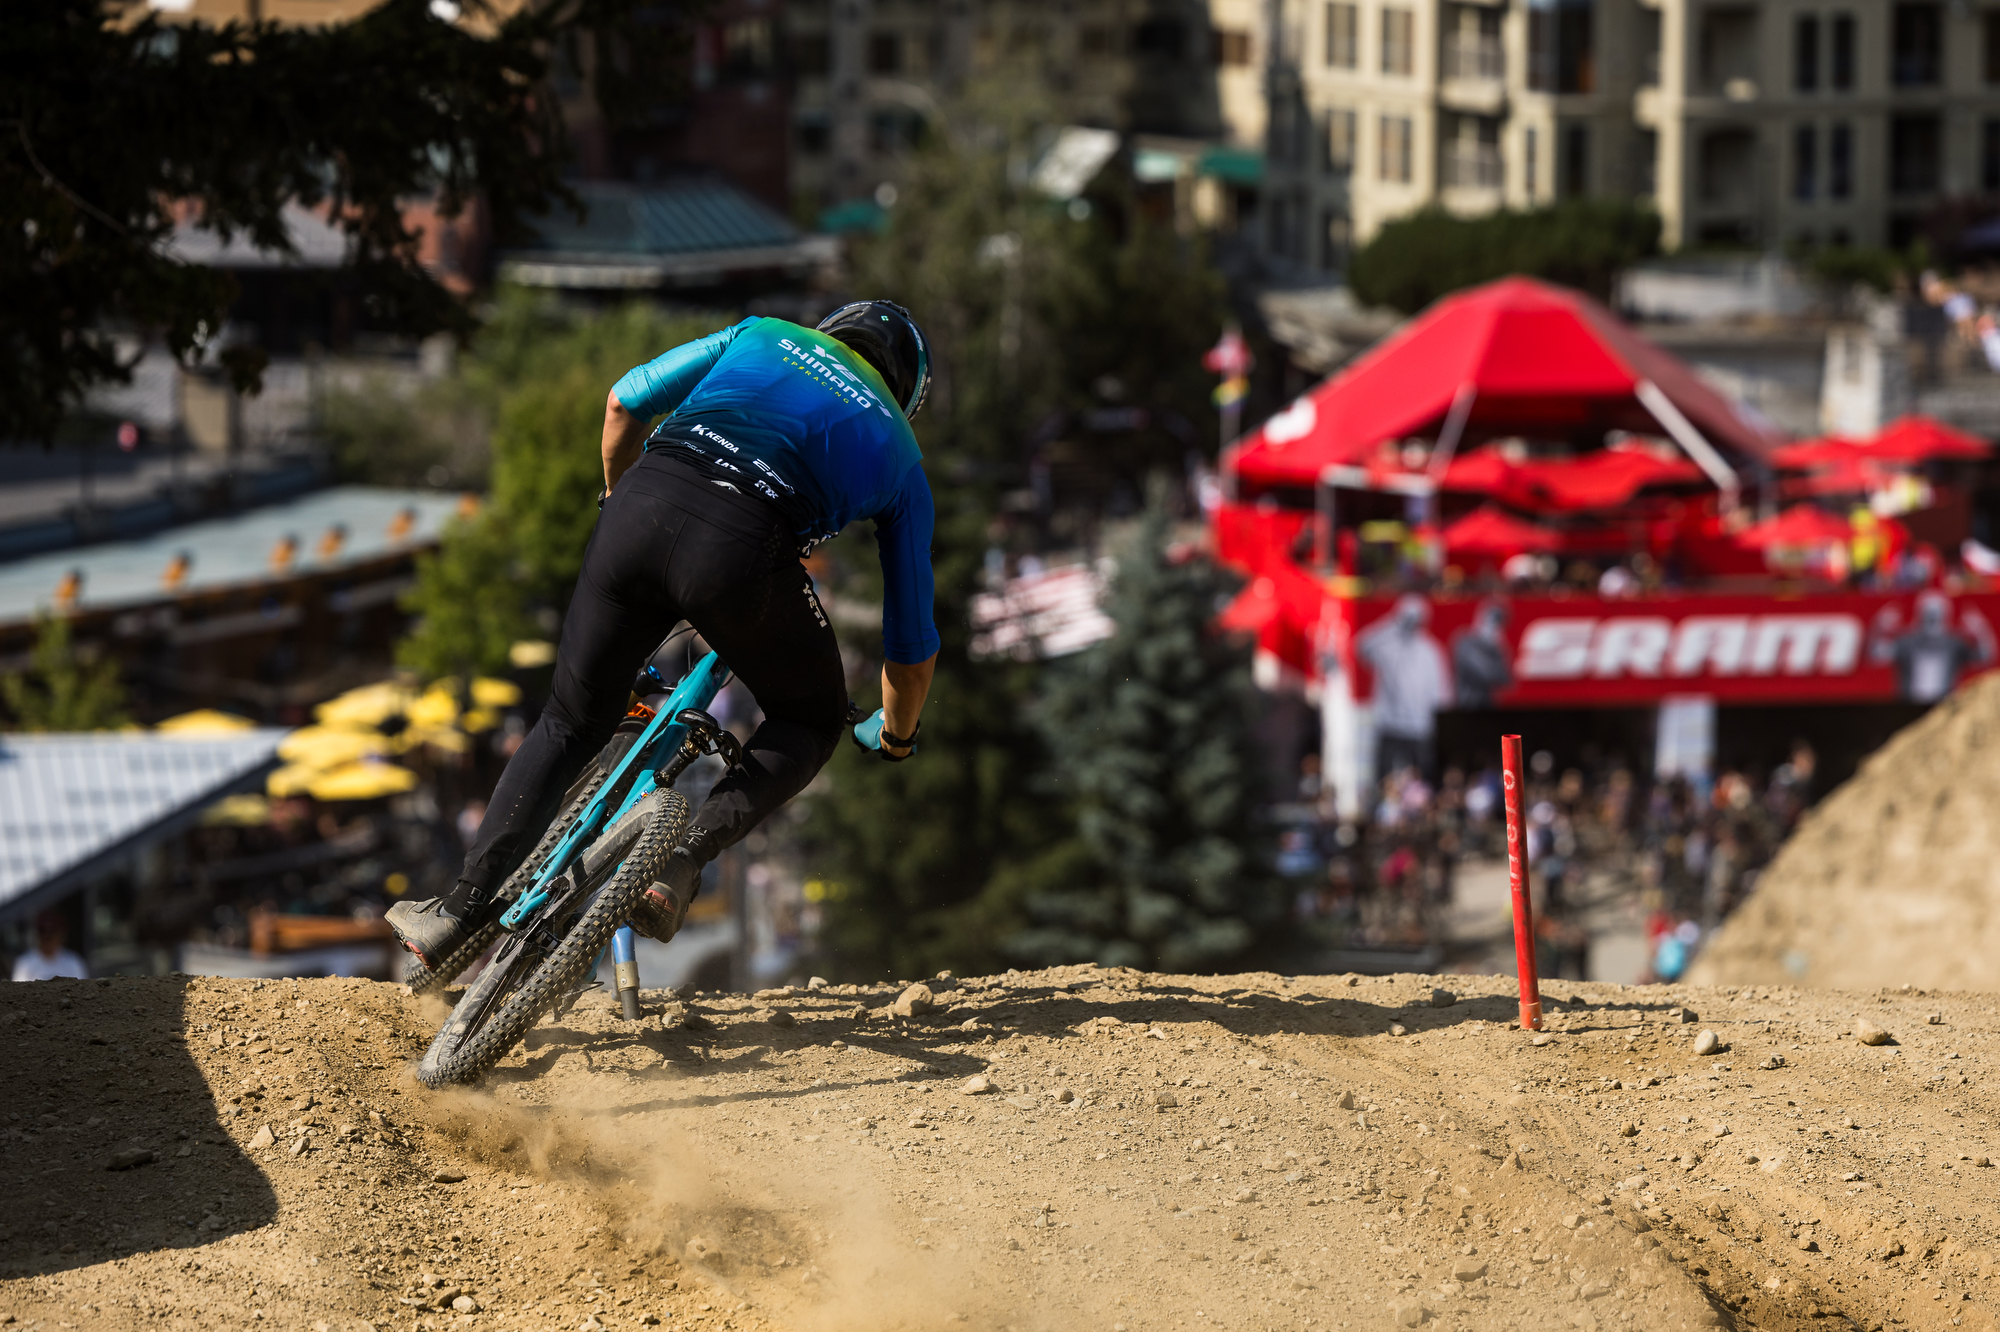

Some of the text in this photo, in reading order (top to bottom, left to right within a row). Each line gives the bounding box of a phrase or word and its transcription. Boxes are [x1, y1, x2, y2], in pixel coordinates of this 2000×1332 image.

[777, 339, 872, 409] SHIMANO
[705, 431, 740, 454] KENDA
[1514, 614, 1864, 680] SRAM
